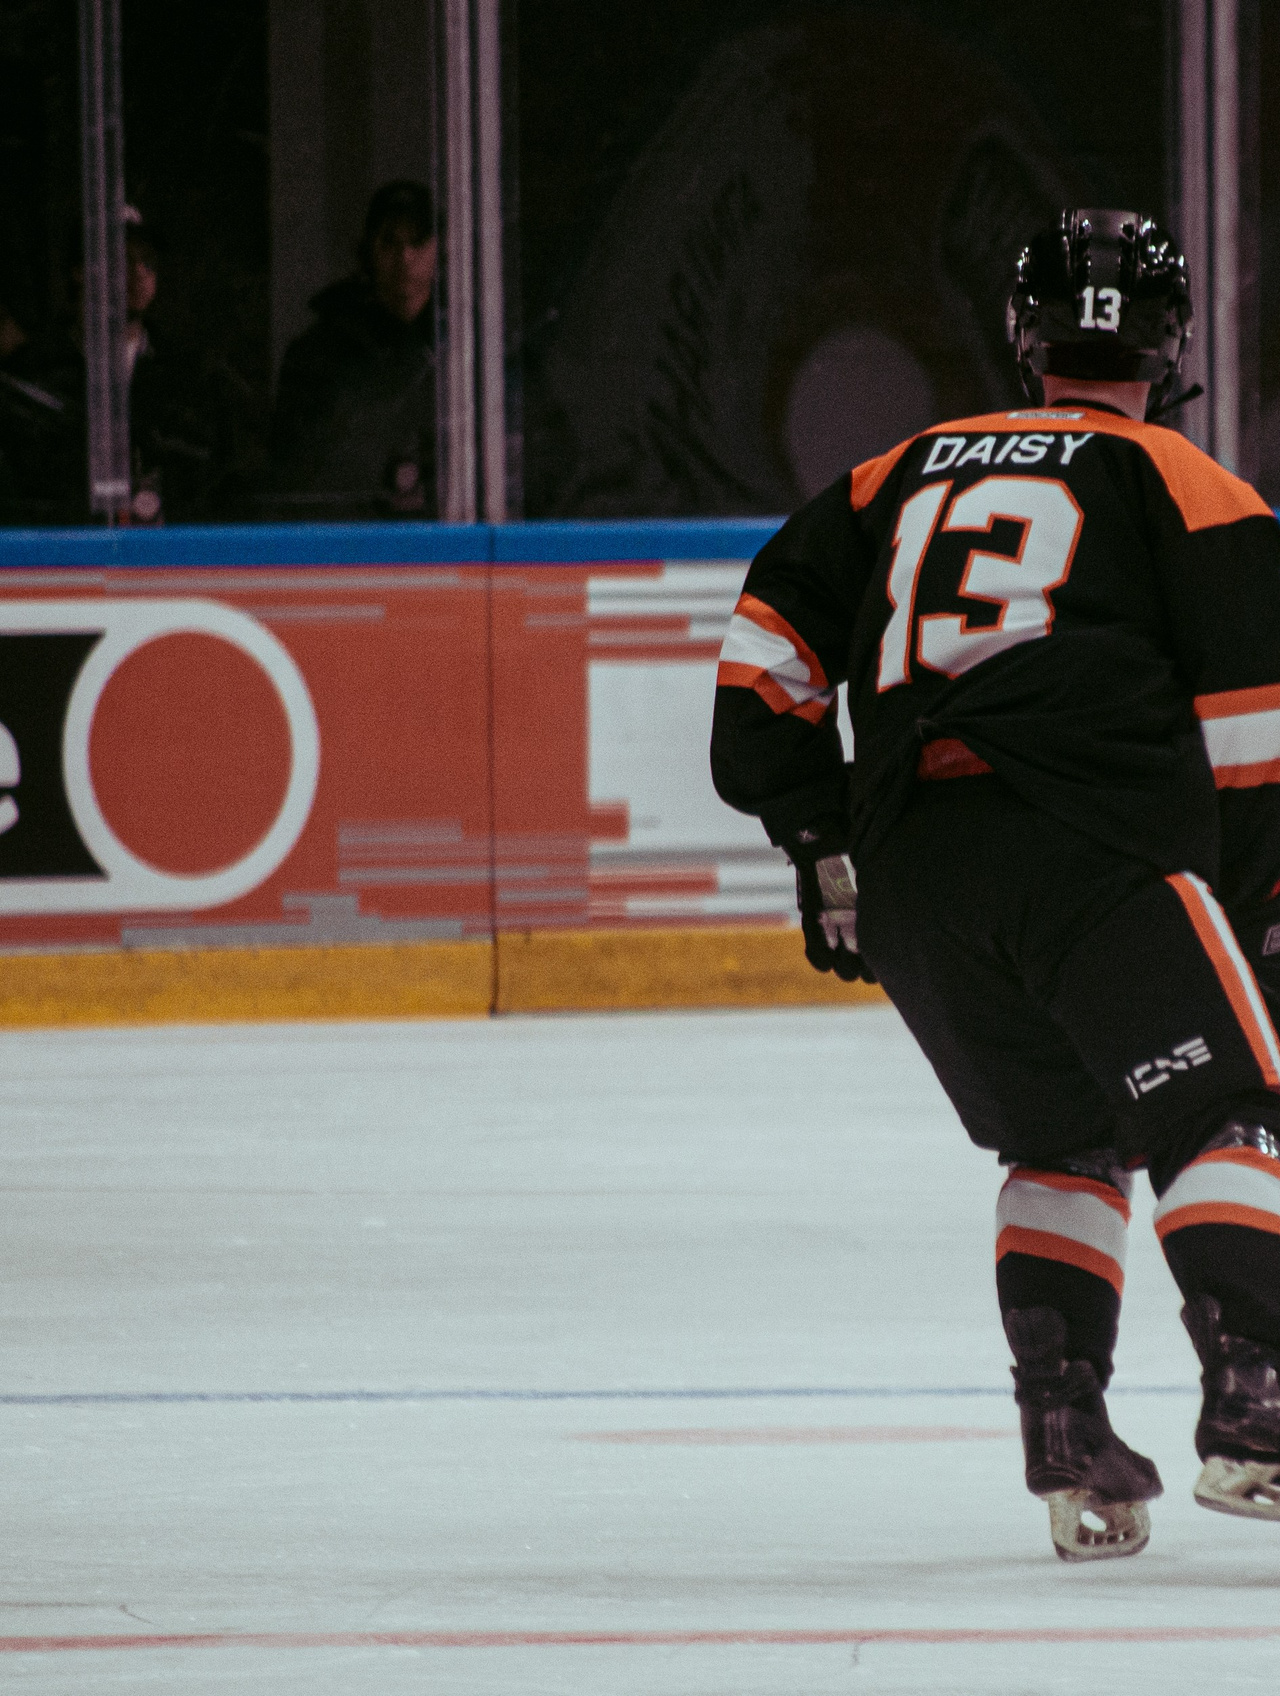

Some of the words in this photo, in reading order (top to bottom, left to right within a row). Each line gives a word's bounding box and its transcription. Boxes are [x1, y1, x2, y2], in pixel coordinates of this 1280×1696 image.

[1079, 286, 1122, 333] 13
[921, 431, 1095, 475] DAISY
[876, 474, 1085, 694] 13
